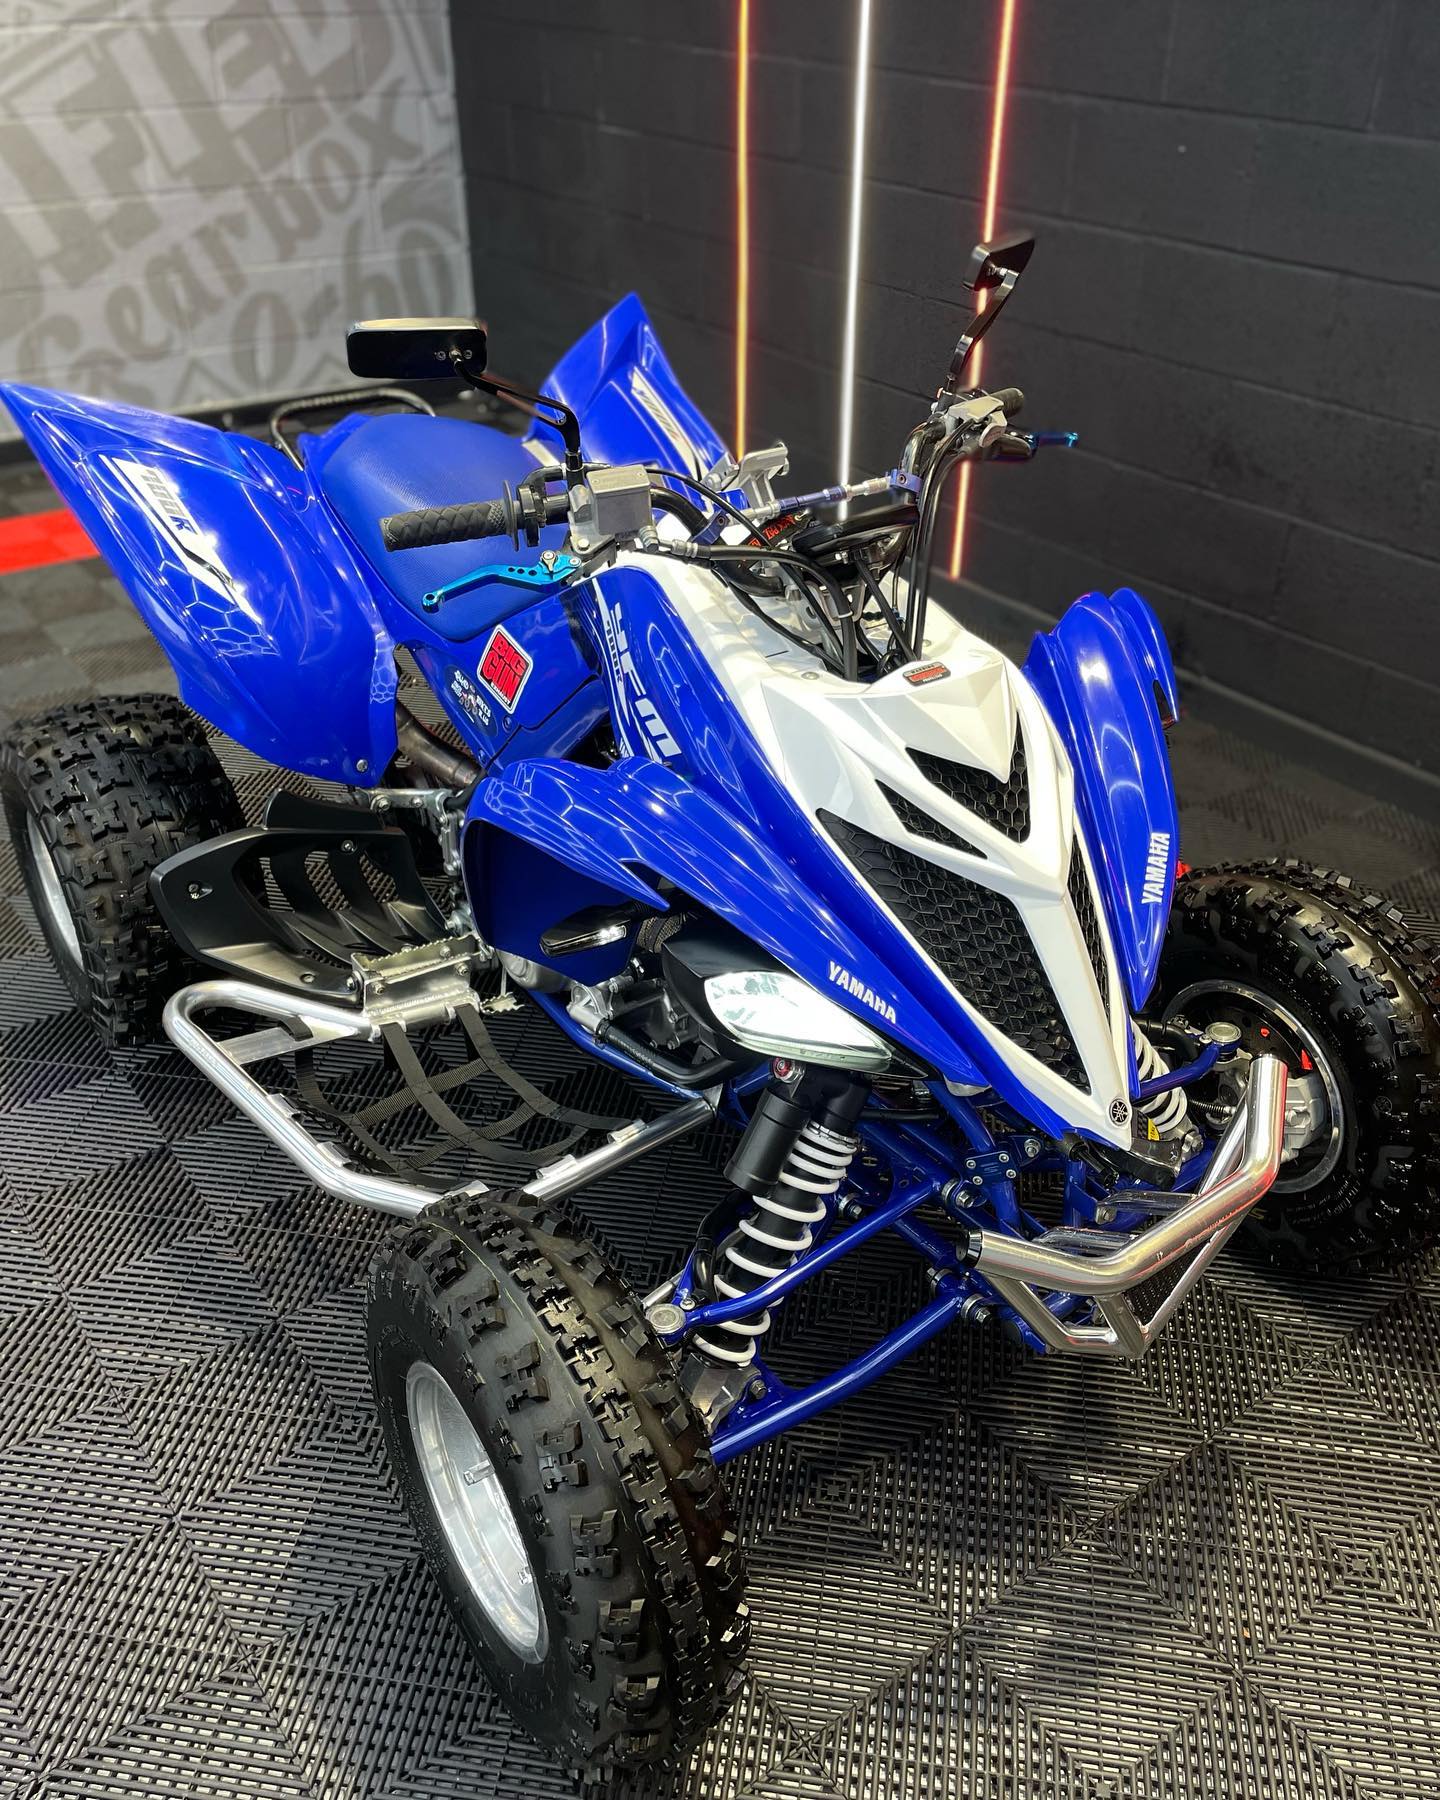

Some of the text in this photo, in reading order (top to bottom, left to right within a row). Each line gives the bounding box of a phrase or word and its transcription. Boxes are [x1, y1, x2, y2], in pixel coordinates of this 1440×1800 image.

[17, 78, 425, 405] Gearbox
[482, 650, 520, 701] GUN
[492, 633, 527, 677] BIG
[1141, 832, 1170, 904] YAMAHA
[829, 960, 896, 1024] YAMAHA
